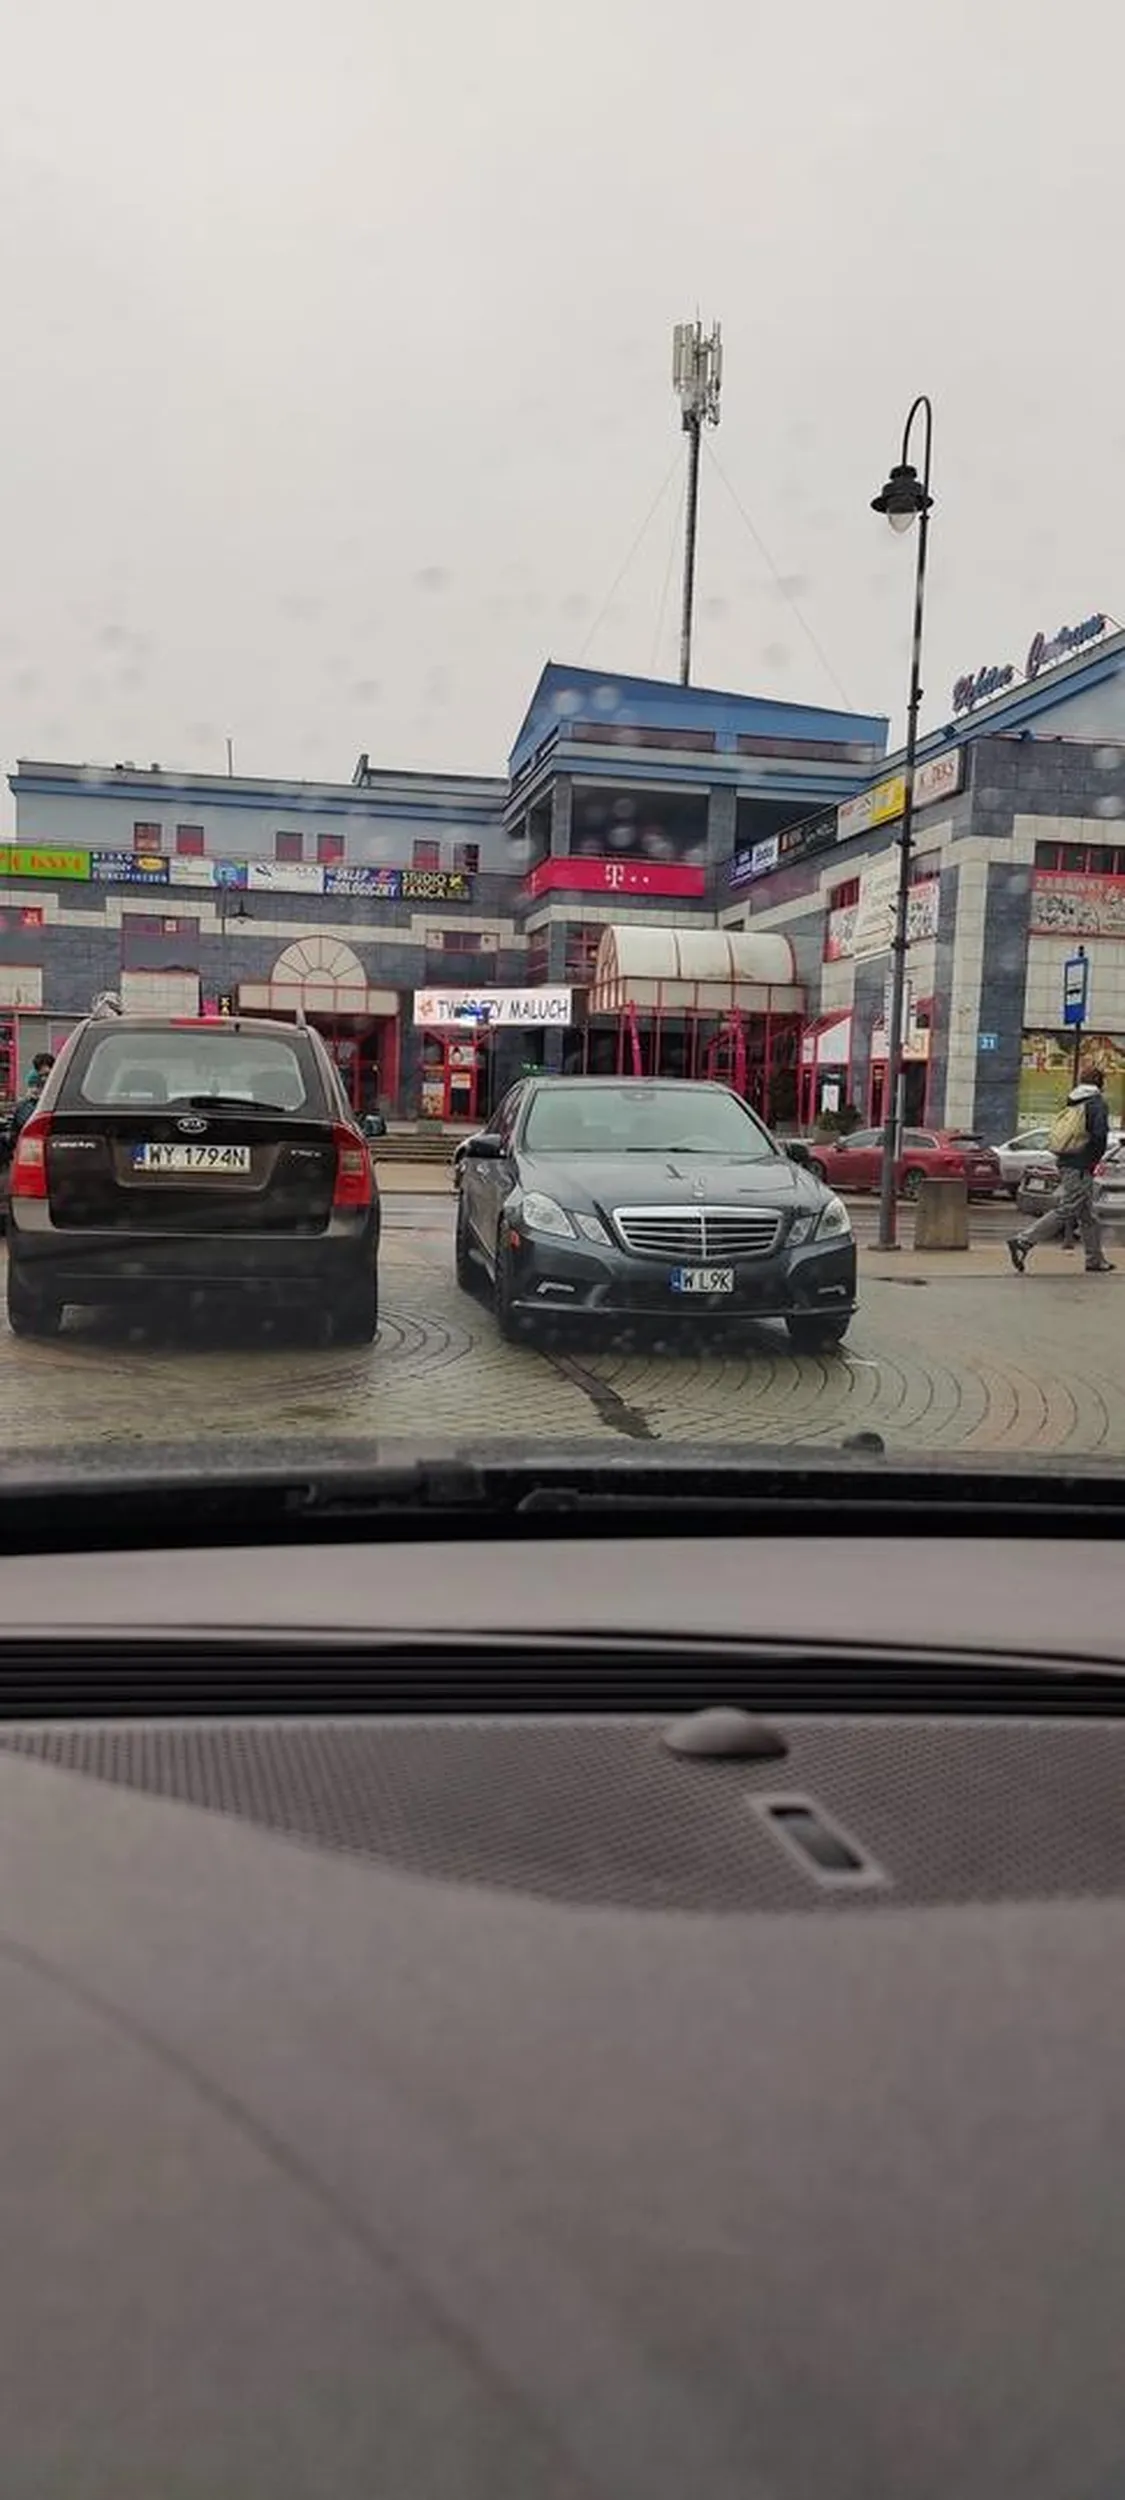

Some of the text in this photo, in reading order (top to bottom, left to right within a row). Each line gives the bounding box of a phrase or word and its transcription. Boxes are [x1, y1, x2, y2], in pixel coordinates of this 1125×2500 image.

[335, 868, 369, 880] SKLEP
[402, 871, 447, 885] STUDIO
[510, 999, 568, 1020] MALUCH
[149, 1146, 244, 1166] WY 1794N
[699, 1271, 730, 1290] L9K
